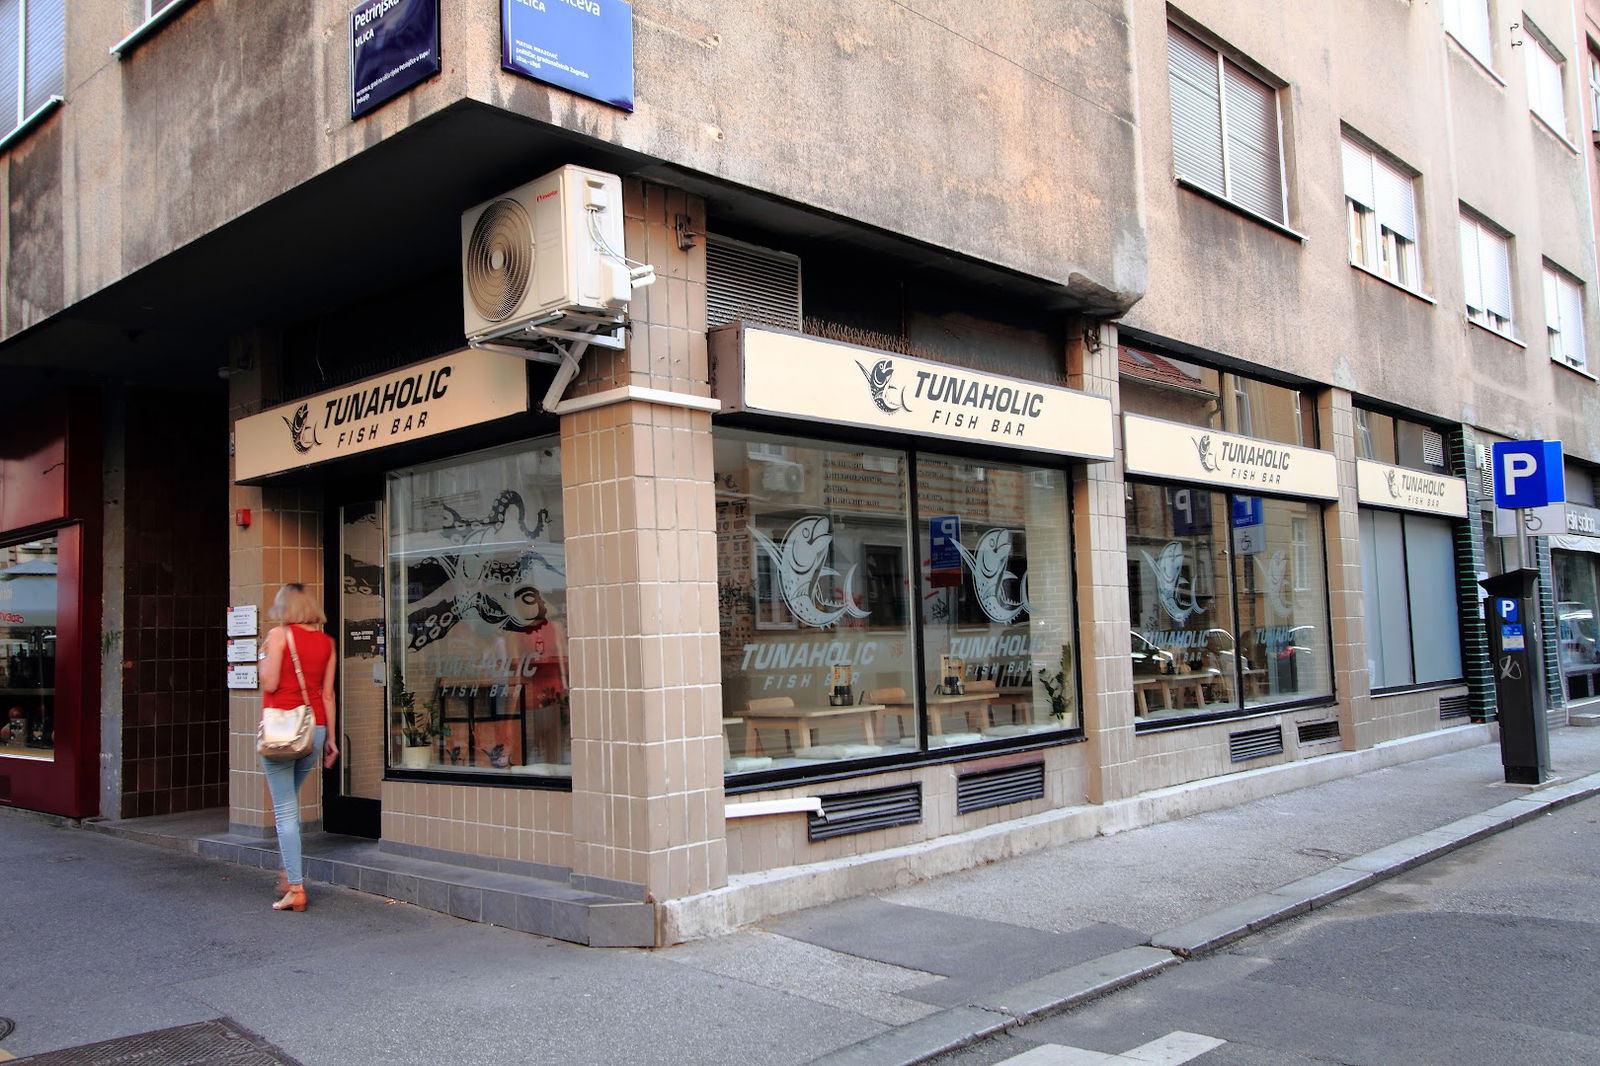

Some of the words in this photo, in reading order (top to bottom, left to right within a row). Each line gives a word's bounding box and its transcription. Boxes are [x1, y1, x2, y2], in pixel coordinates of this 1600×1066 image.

[516, 0, 546, 13] LICA
[355, 28, 374, 47] ULICA
[324, 366, 452, 429] TUNAHOLIC
[914, 370, 1044, 418] TUNAHOLIC
[337, 423, 378, 448] FISH
[391, 411, 428, 435] BAR
[932, 410, 978, 429] FISH
[991, 419, 1025, 437] BAR
[1221, 441, 1291, 470] TUNAHOLIC
[1231, 468, 1256, 482] FISH
[1262, 473, 1281, 485] BAR
[1401, 473, 1445, 497] TUNAHOLIC
[1503, 452, 1537, 496] P
[1502, 600, 1515, 618] P
[741, 641, 877, 670] TUNAHOLIC
[965, 662, 1000, 677] FISH
[441, 684, 479, 698] FISH
[489, 683, 523, 698] BAR
[763, 674, 812, 691] FISH
